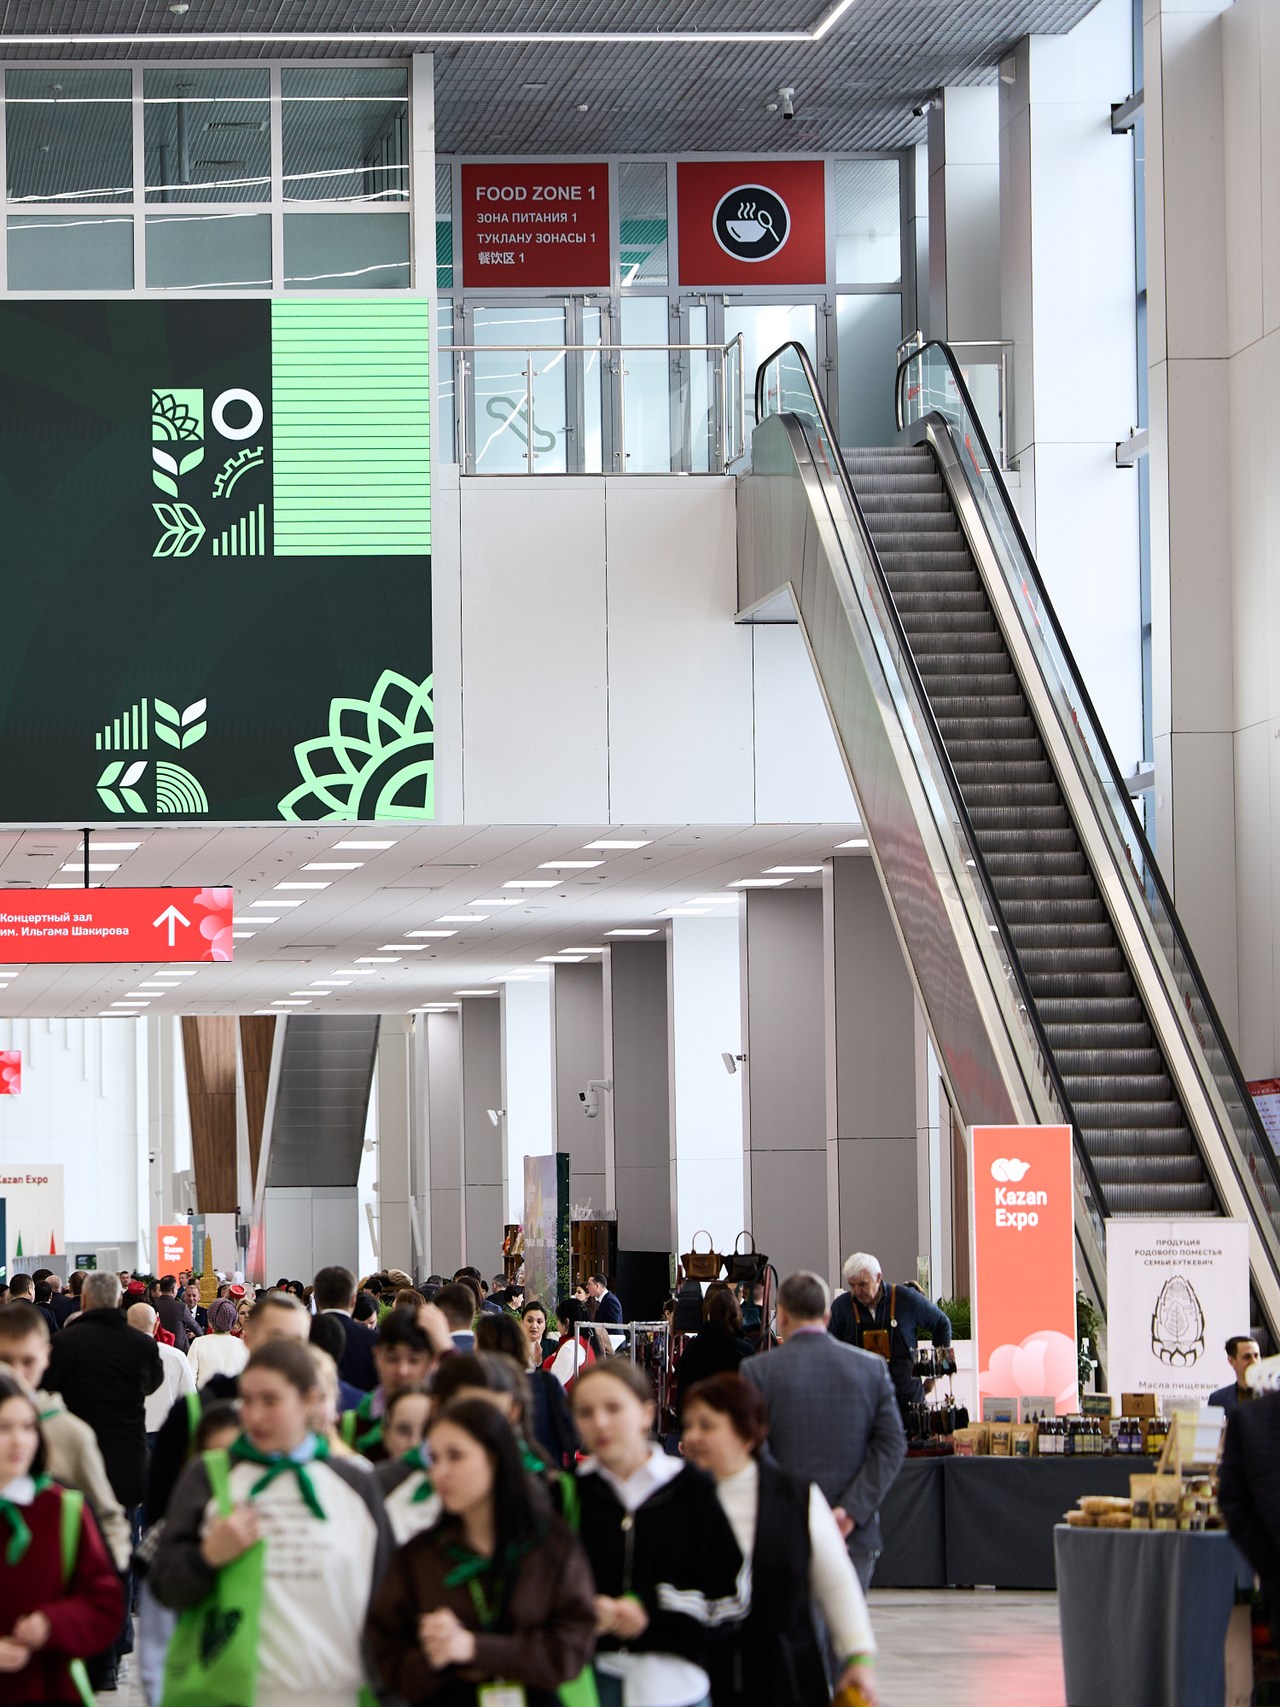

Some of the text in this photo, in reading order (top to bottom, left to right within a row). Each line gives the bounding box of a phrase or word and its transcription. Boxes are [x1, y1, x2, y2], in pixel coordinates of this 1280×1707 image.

[477, 186, 594, 201] FOOD ZONE 1
[477, 213, 576, 223] ЗОНА ПИТАНИЯ 1
[477, 233, 595, 243] ТУКЛАНУ ЗОНАСЫ 1
[519, 253, 524, 262] 1
[0, 913, 70, 924] Концертный
[22, 927, 68, 936] Ильгама
[72, 927, 129, 937] Шакирова
[26, 1175, 49, 1186] Expo
[995, 1187, 1047, 1205] Kazan
[996, 1208, 1038, 1231] Expo
[1139, 1381, 1170, 1389] Масла
